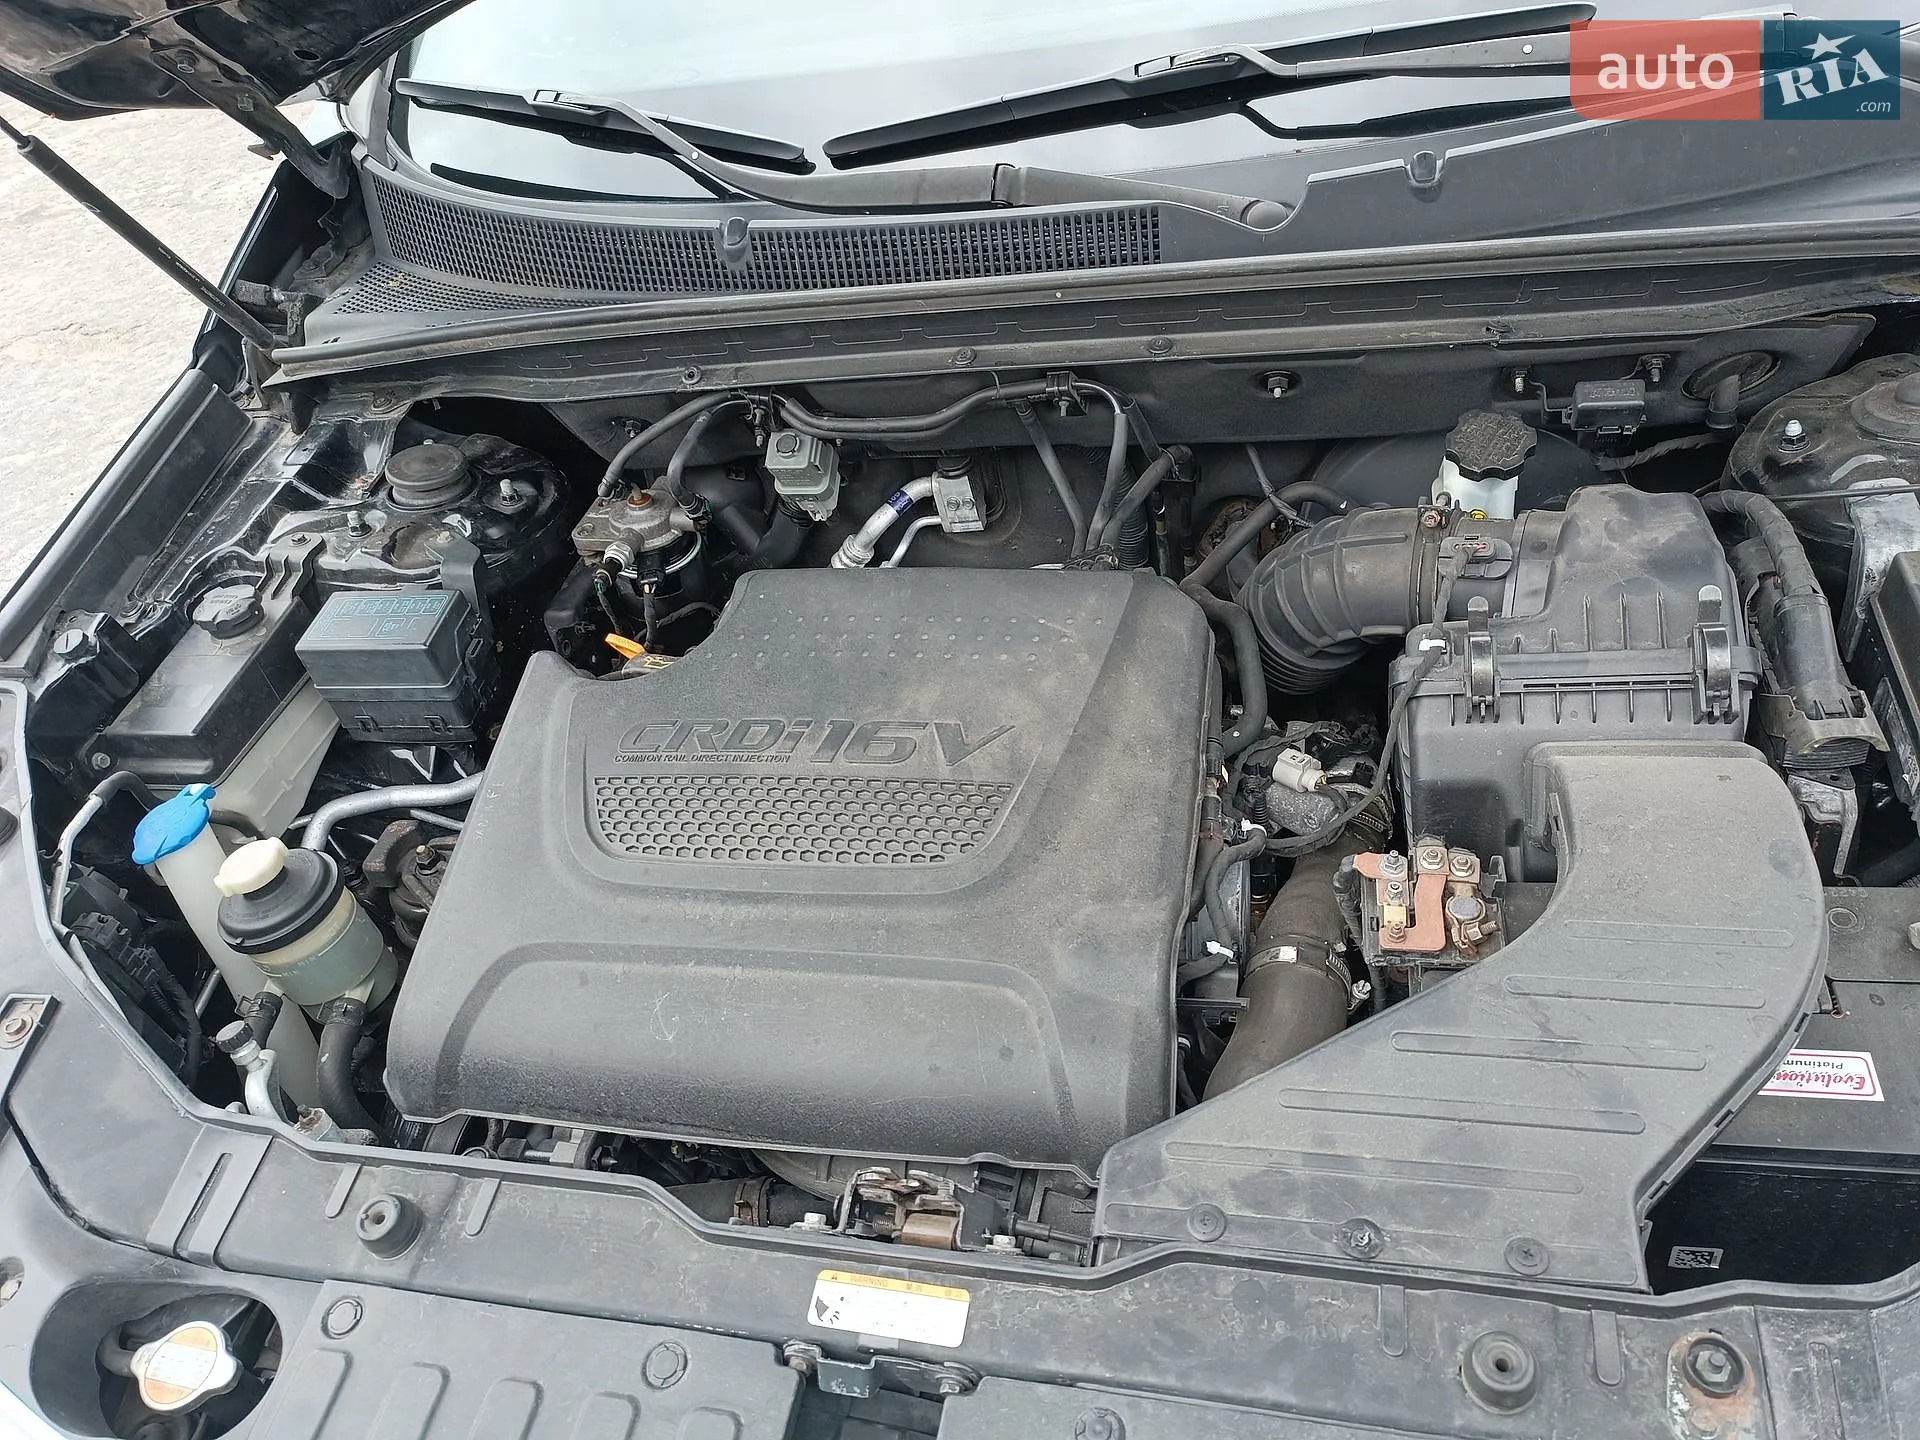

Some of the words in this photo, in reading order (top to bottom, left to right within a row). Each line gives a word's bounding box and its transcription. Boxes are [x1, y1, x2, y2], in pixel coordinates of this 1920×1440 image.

[614, 754, 662, 763] COMMON
[663, 754, 688, 763] RAIL
[690, 754, 729, 763] DIRECT
[732, 754, 791, 763] INJECTION
[1782, 1060, 1843, 1070] Platinum
[1776, 1071, 1866, 1090] Evolution
